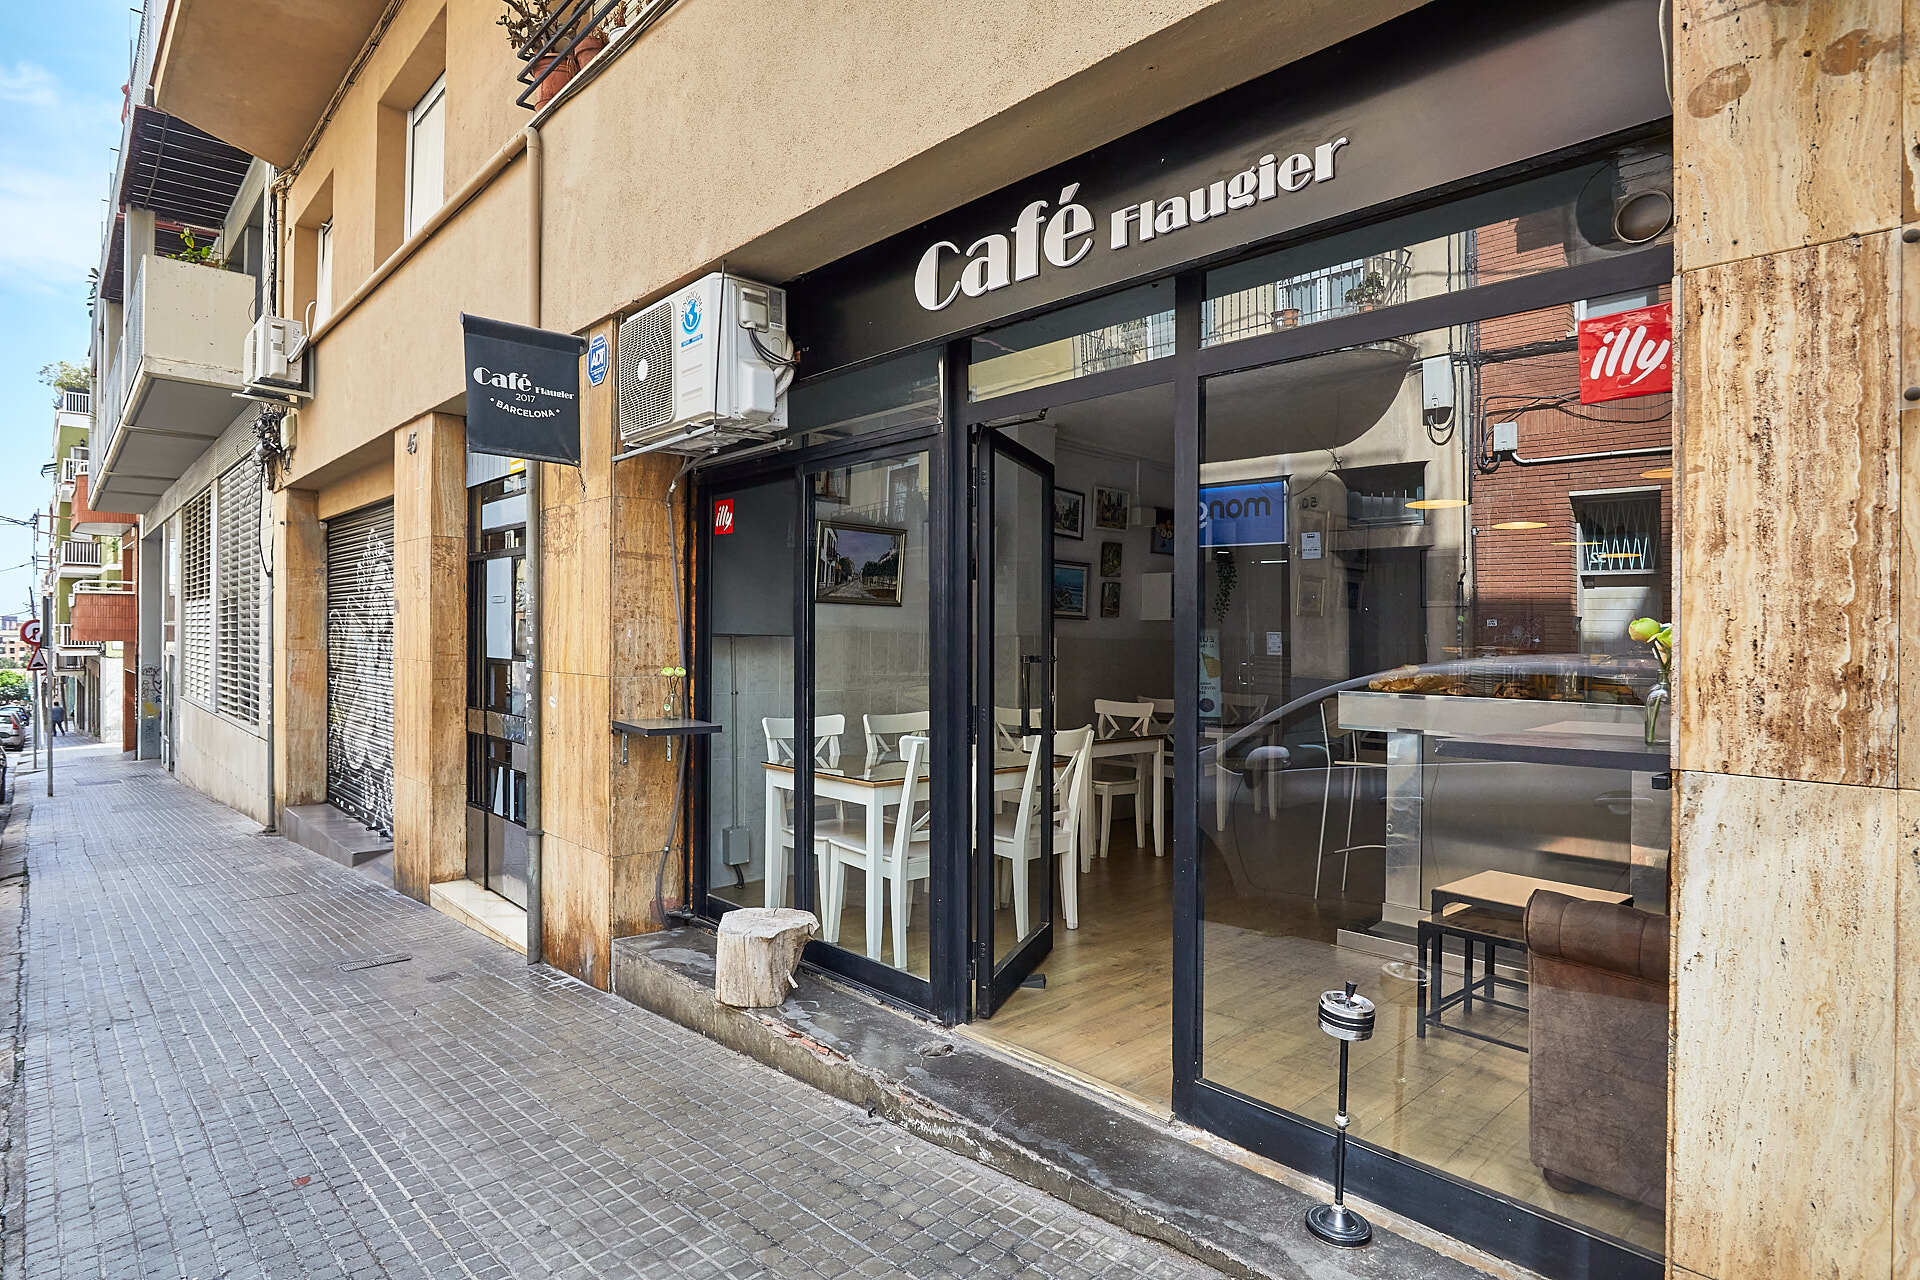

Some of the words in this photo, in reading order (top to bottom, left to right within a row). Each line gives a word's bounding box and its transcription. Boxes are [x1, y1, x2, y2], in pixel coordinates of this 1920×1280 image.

[914, 182, 1095, 312] Café
[1110, 136, 1349, 251] Flaugier
[1590, 325, 1671, 385] illy
[473, 366, 532, 392] Café
[496, 399, 556, 418] BARCELONA
[515, 393, 536, 403] 2017
[715, 504, 733, 531] illy
